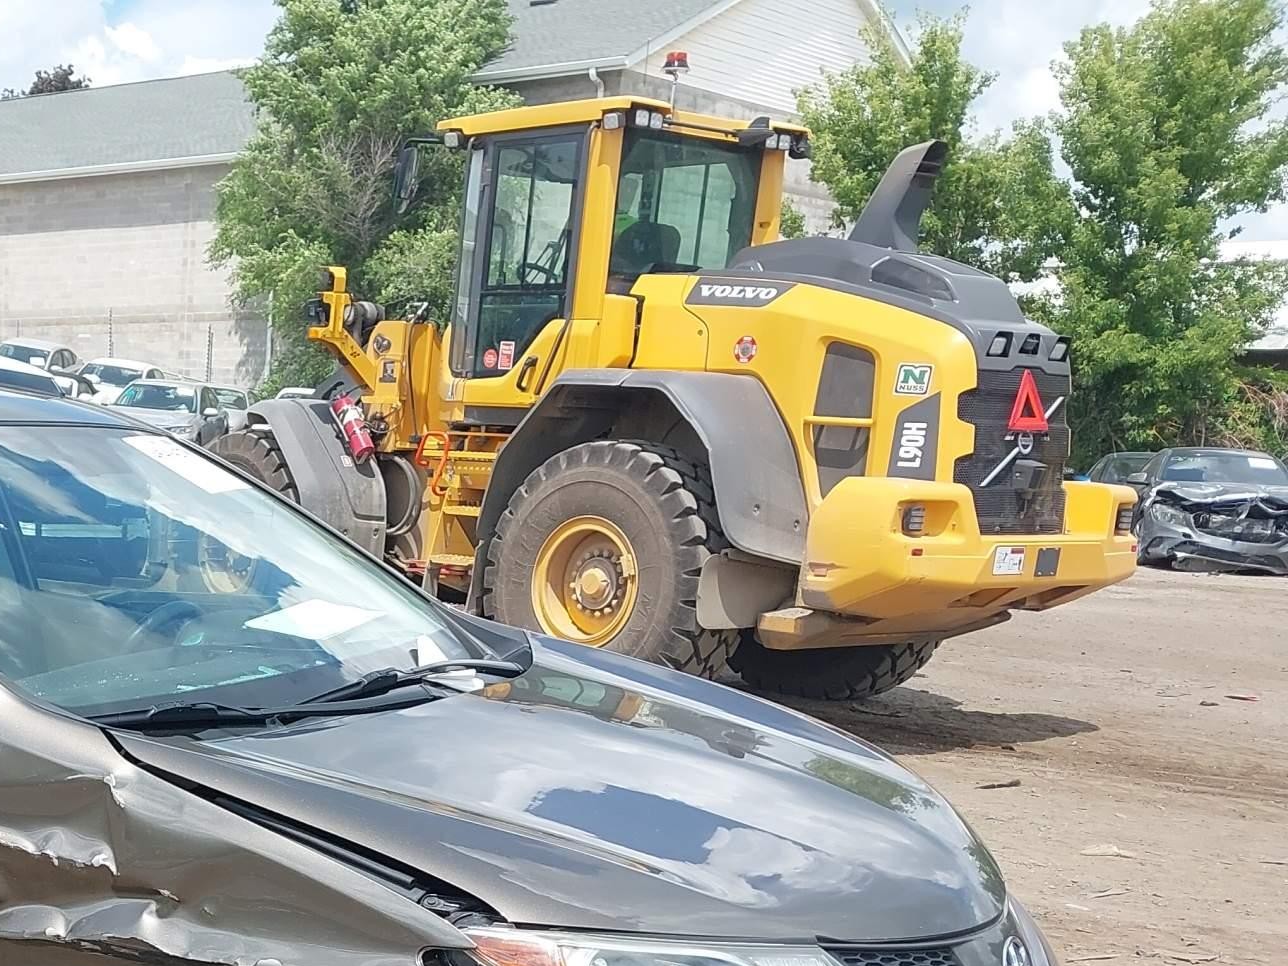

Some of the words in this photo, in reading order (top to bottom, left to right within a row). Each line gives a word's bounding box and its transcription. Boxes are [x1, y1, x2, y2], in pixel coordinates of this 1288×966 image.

[700, 285, 778, 300] VOLVO
[900, 369, 929, 385] N
[897, 422, 928, 468] L90H
